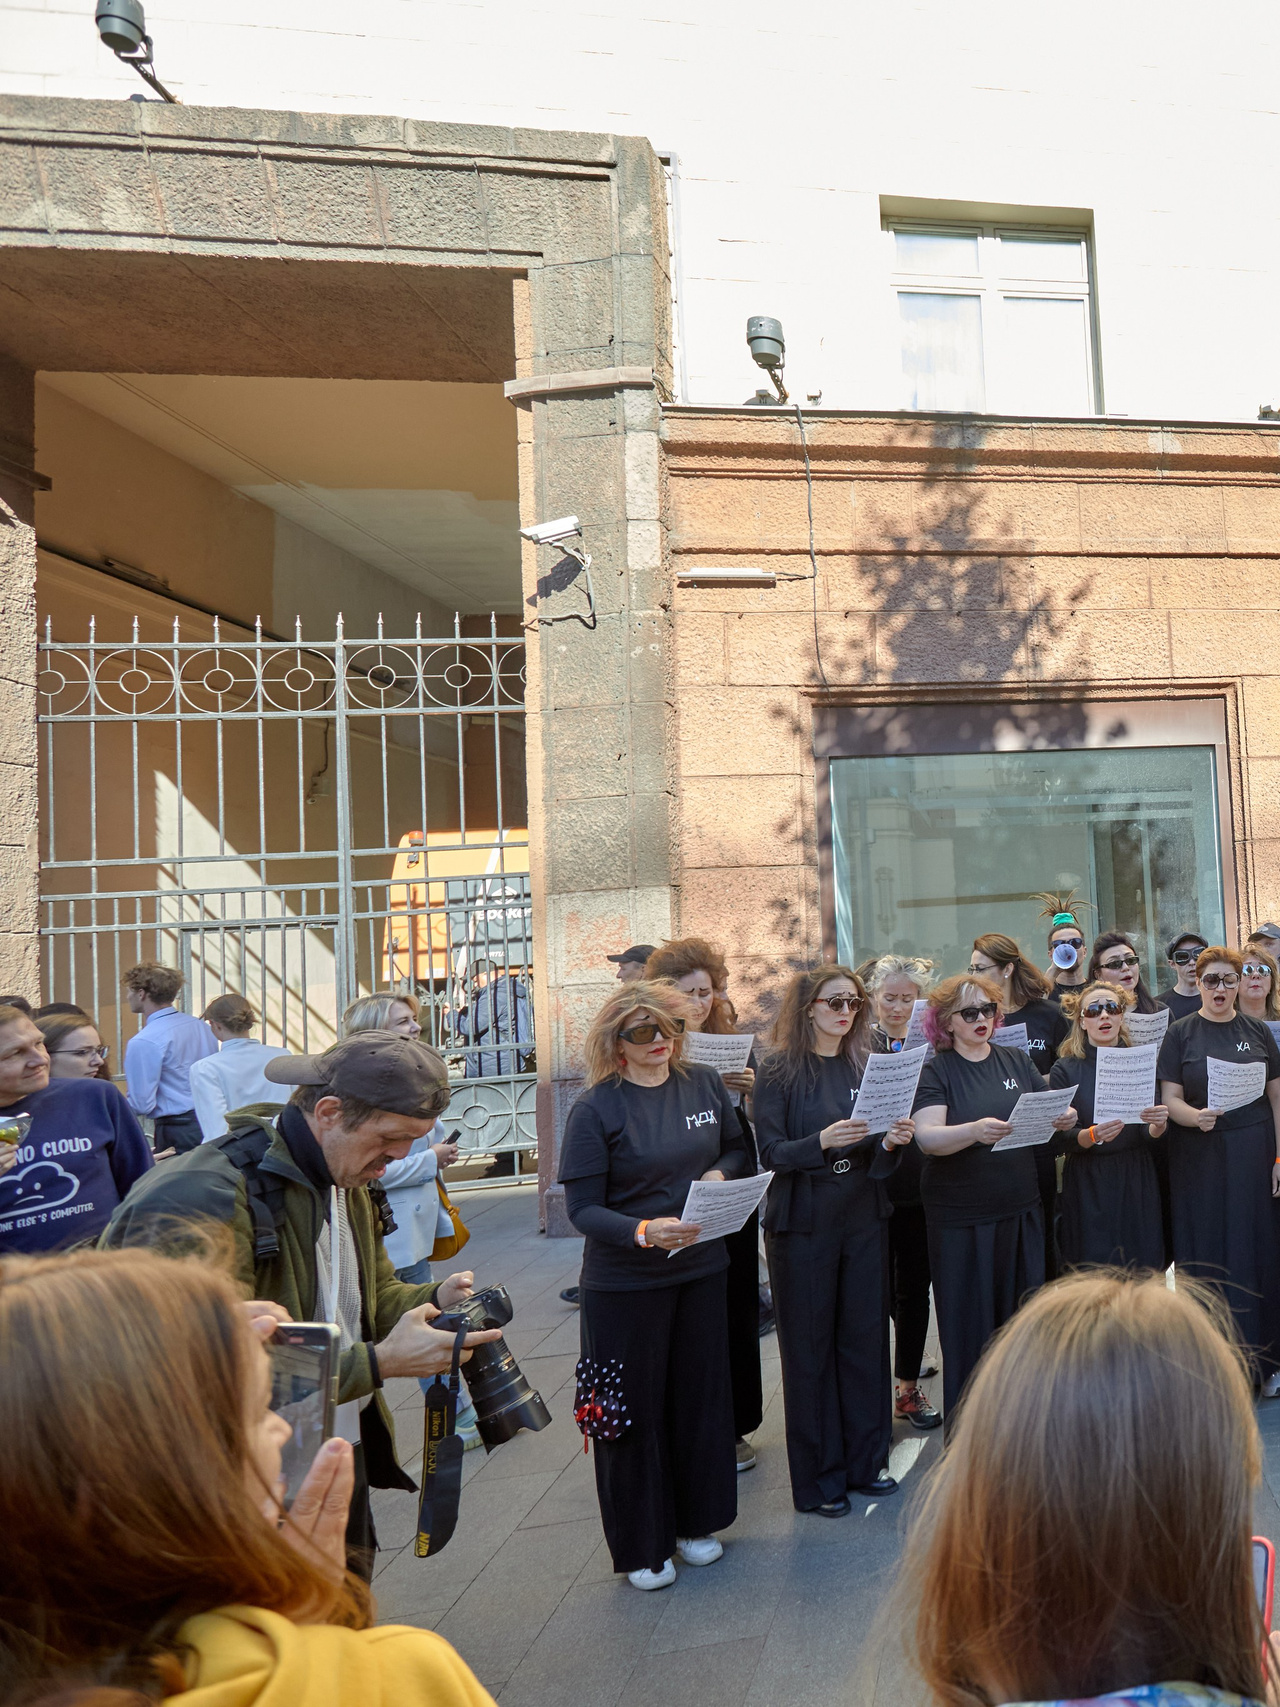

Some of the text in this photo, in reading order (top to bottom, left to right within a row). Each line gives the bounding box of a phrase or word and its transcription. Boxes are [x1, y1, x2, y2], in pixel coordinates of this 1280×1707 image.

[42, 1138, 92, 1157] CLOUD
[17, 1213, 48, 1229] ELSE'S
[431, 1410, 441, 1437] Nikon
